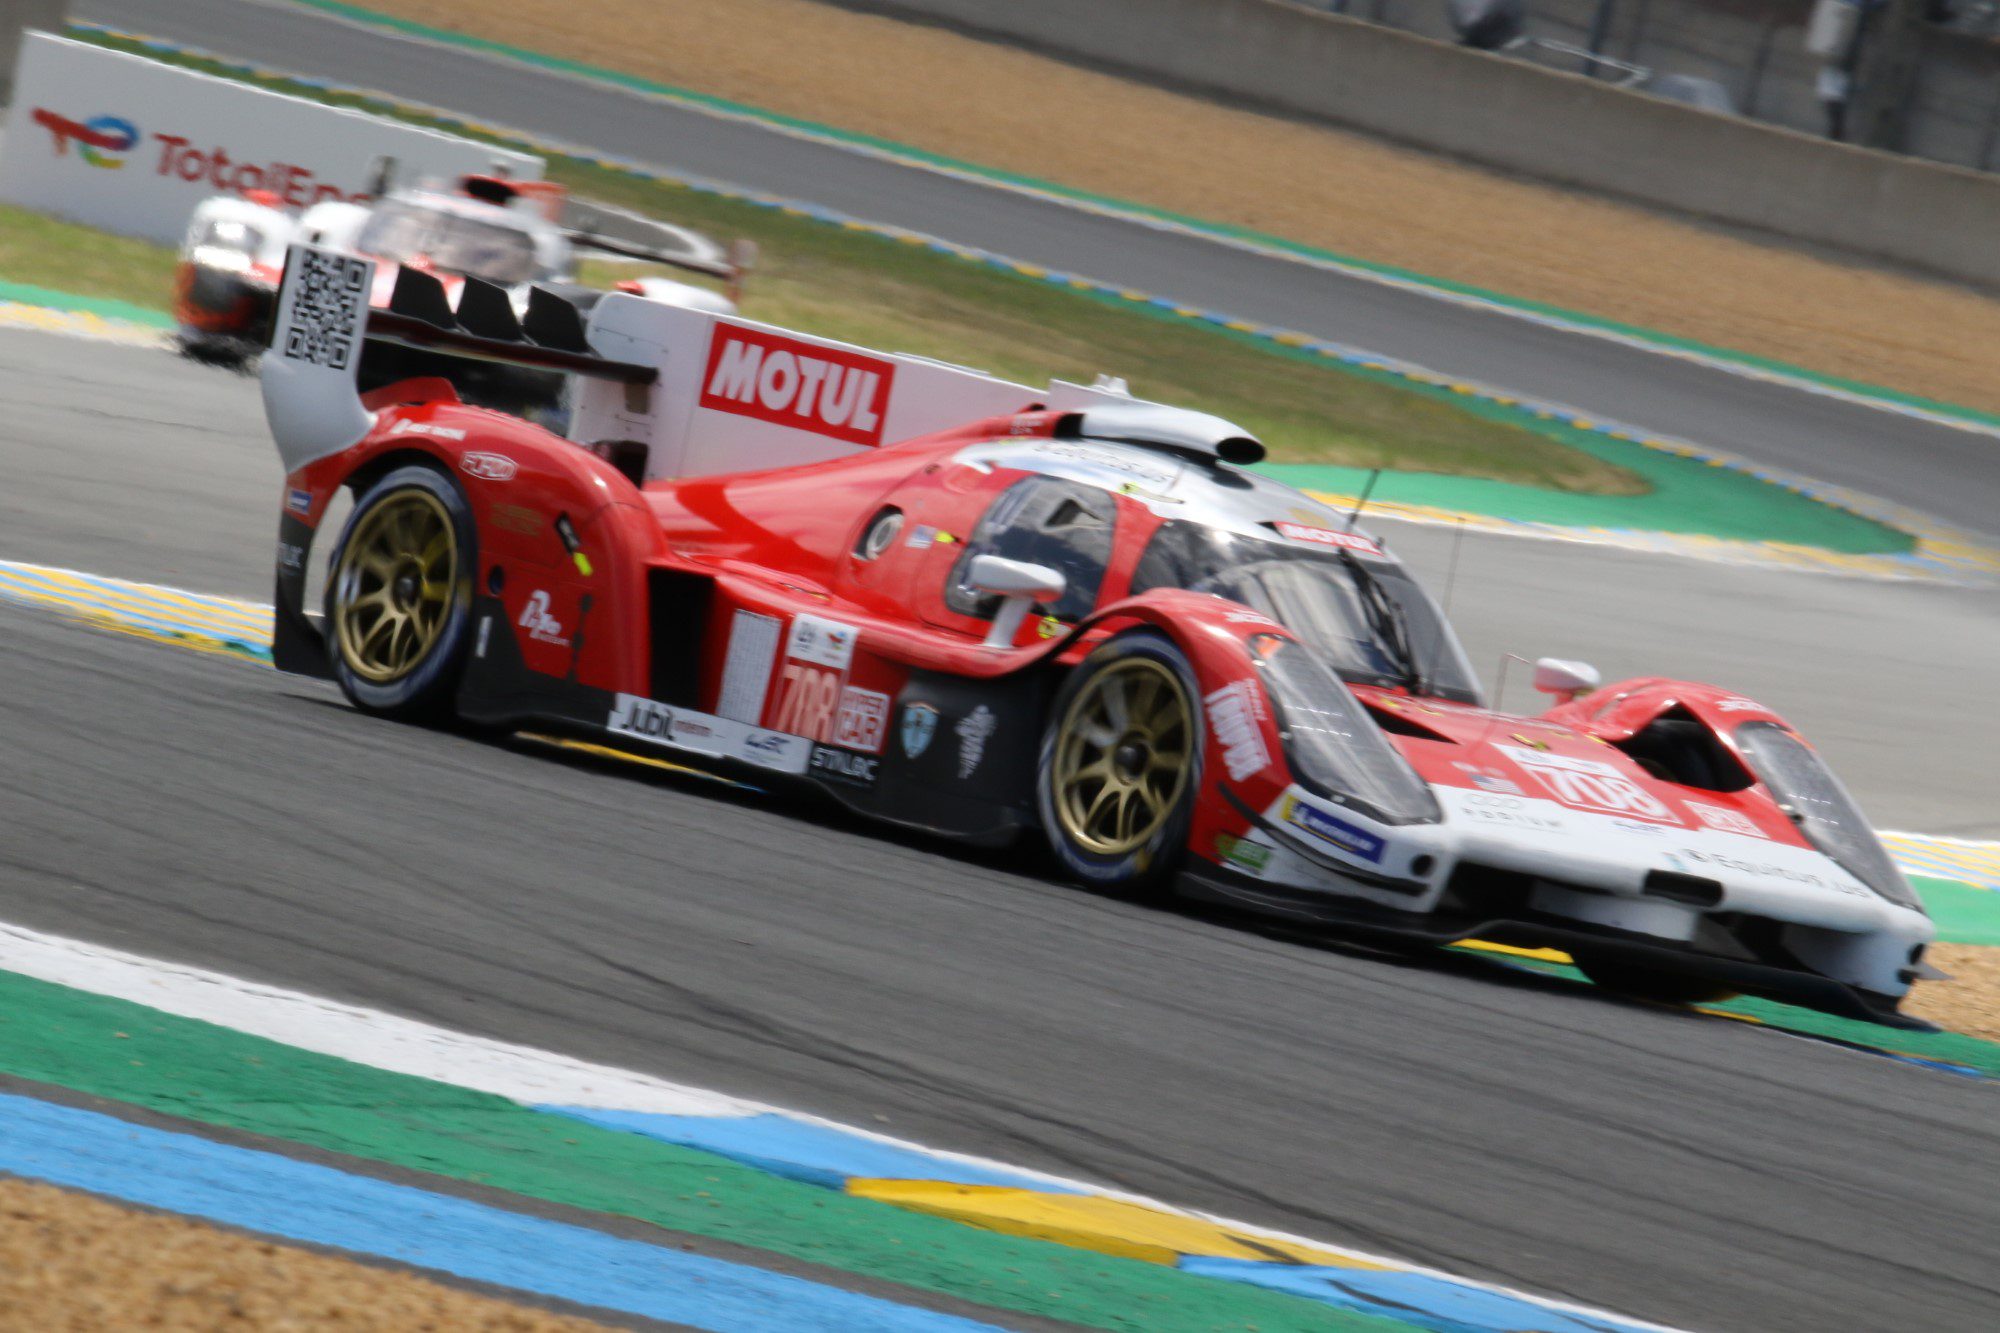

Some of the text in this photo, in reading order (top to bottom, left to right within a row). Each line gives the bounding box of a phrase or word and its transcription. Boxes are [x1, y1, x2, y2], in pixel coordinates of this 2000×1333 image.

[707, 337, 881, 433] MOTUL
[776, 664, 839, 744] 708
[1532, 765, 1668, 819] 708
